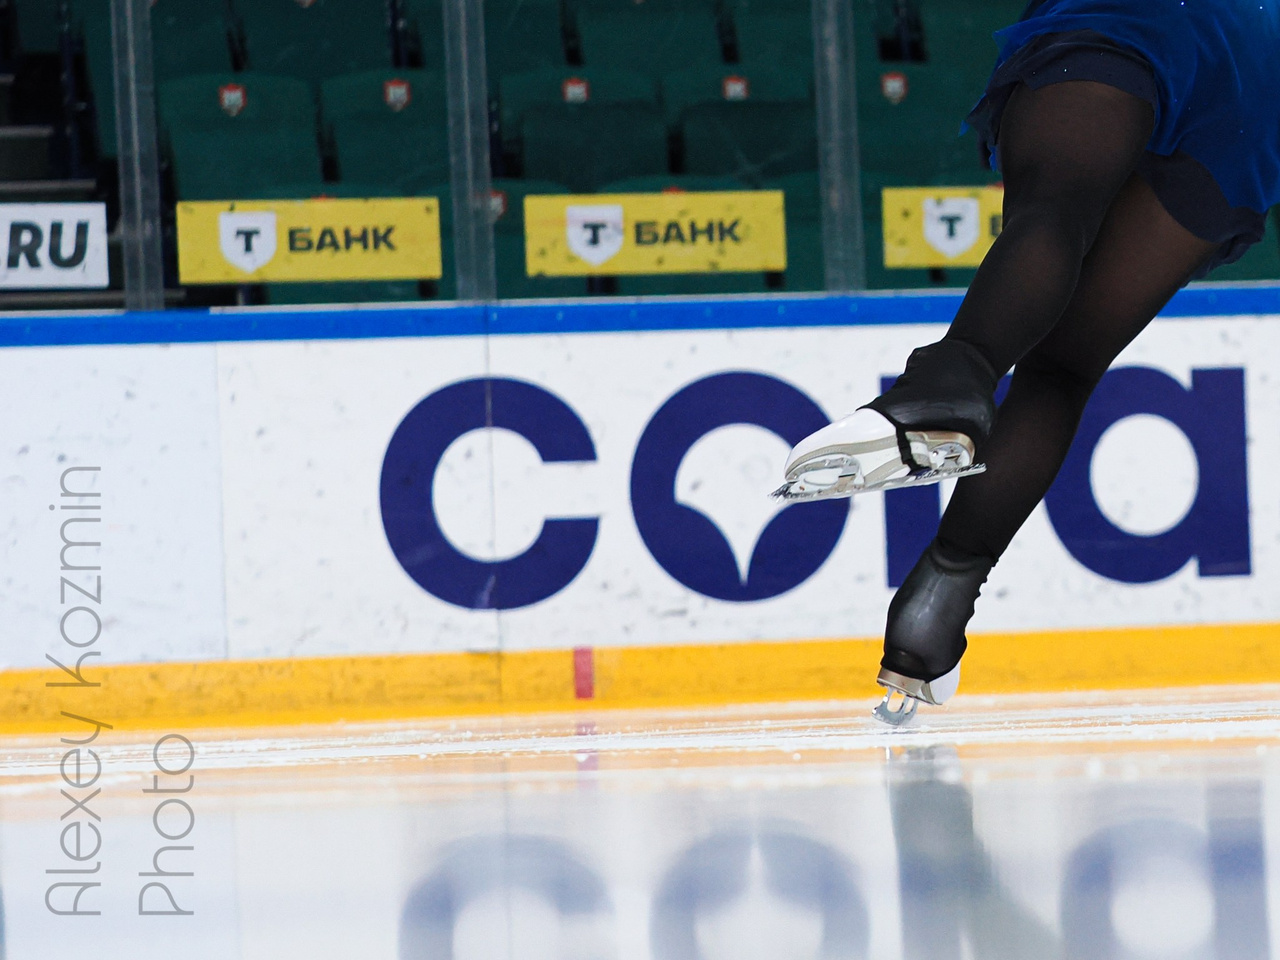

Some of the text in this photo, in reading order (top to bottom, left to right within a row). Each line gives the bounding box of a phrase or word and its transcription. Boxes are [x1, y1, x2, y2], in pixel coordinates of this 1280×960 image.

[7, 221, 89, 269] RU
[235, 225, 396, 253] Т БАНК
[583, 219, 741, 246] Т БАНК
